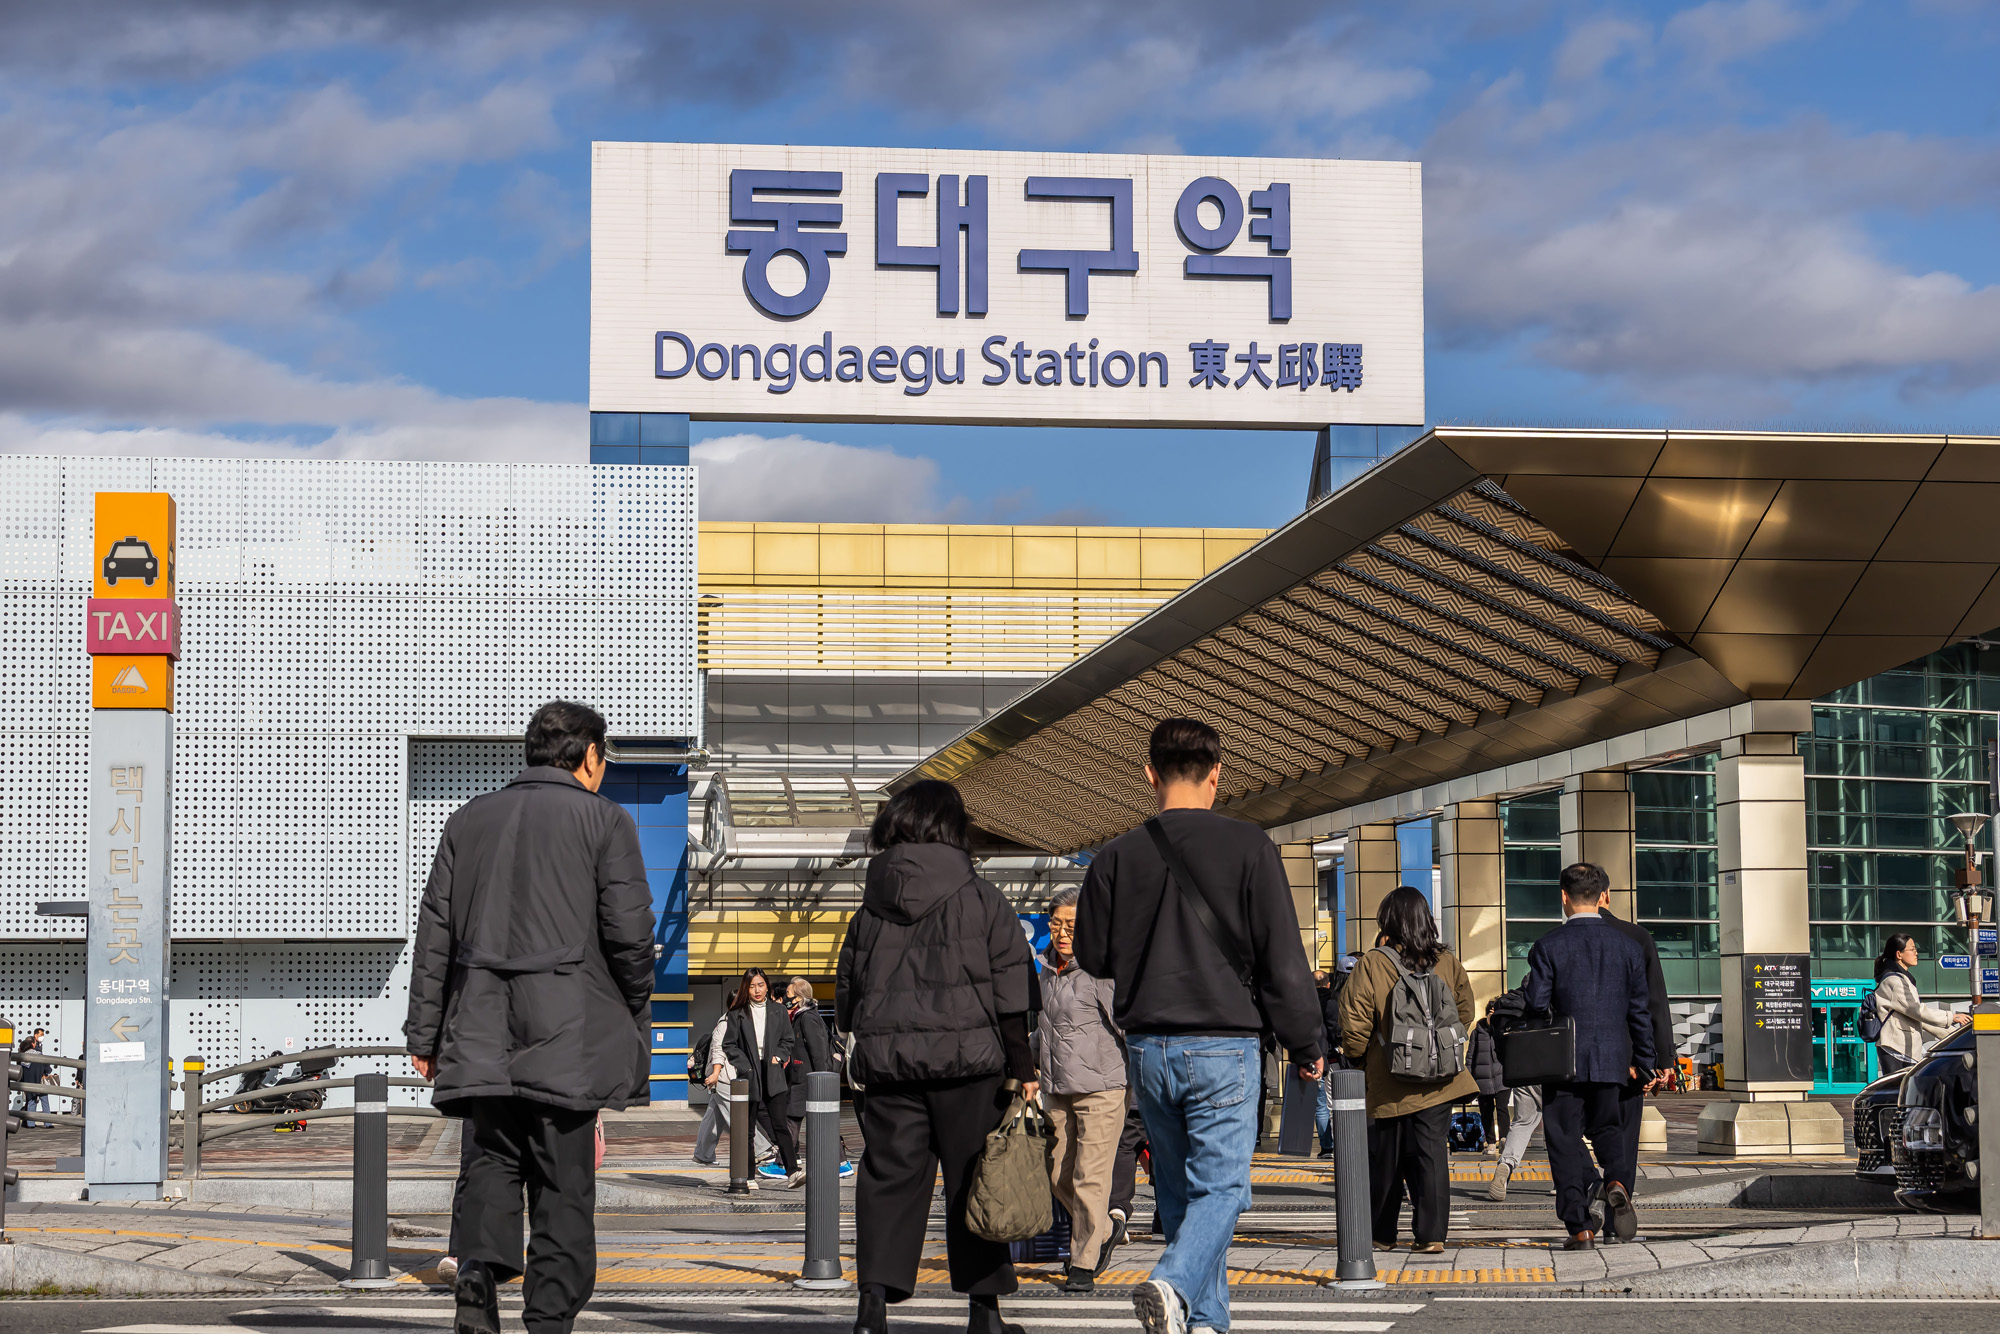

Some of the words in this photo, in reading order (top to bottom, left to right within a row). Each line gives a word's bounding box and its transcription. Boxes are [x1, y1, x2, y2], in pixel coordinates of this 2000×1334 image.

[726, 168, 1293, 323] 동대구역
[655, 331, 965, 396] Dongdaegu
[981, 335, 1169, 388] Station
[1188, 338, 1363, 393] 東大邱驛
[91, 611, 168, 641] TAXI
[107, 766, 144, 965] 택시타는곳
[96, 996, 138, 1005] Dongdaegu
[139, 996, 153, 1004] Stn.
[98, 979, 150, 994] 동대구역
[1825, 987, 1856, 996] iM뱅크
